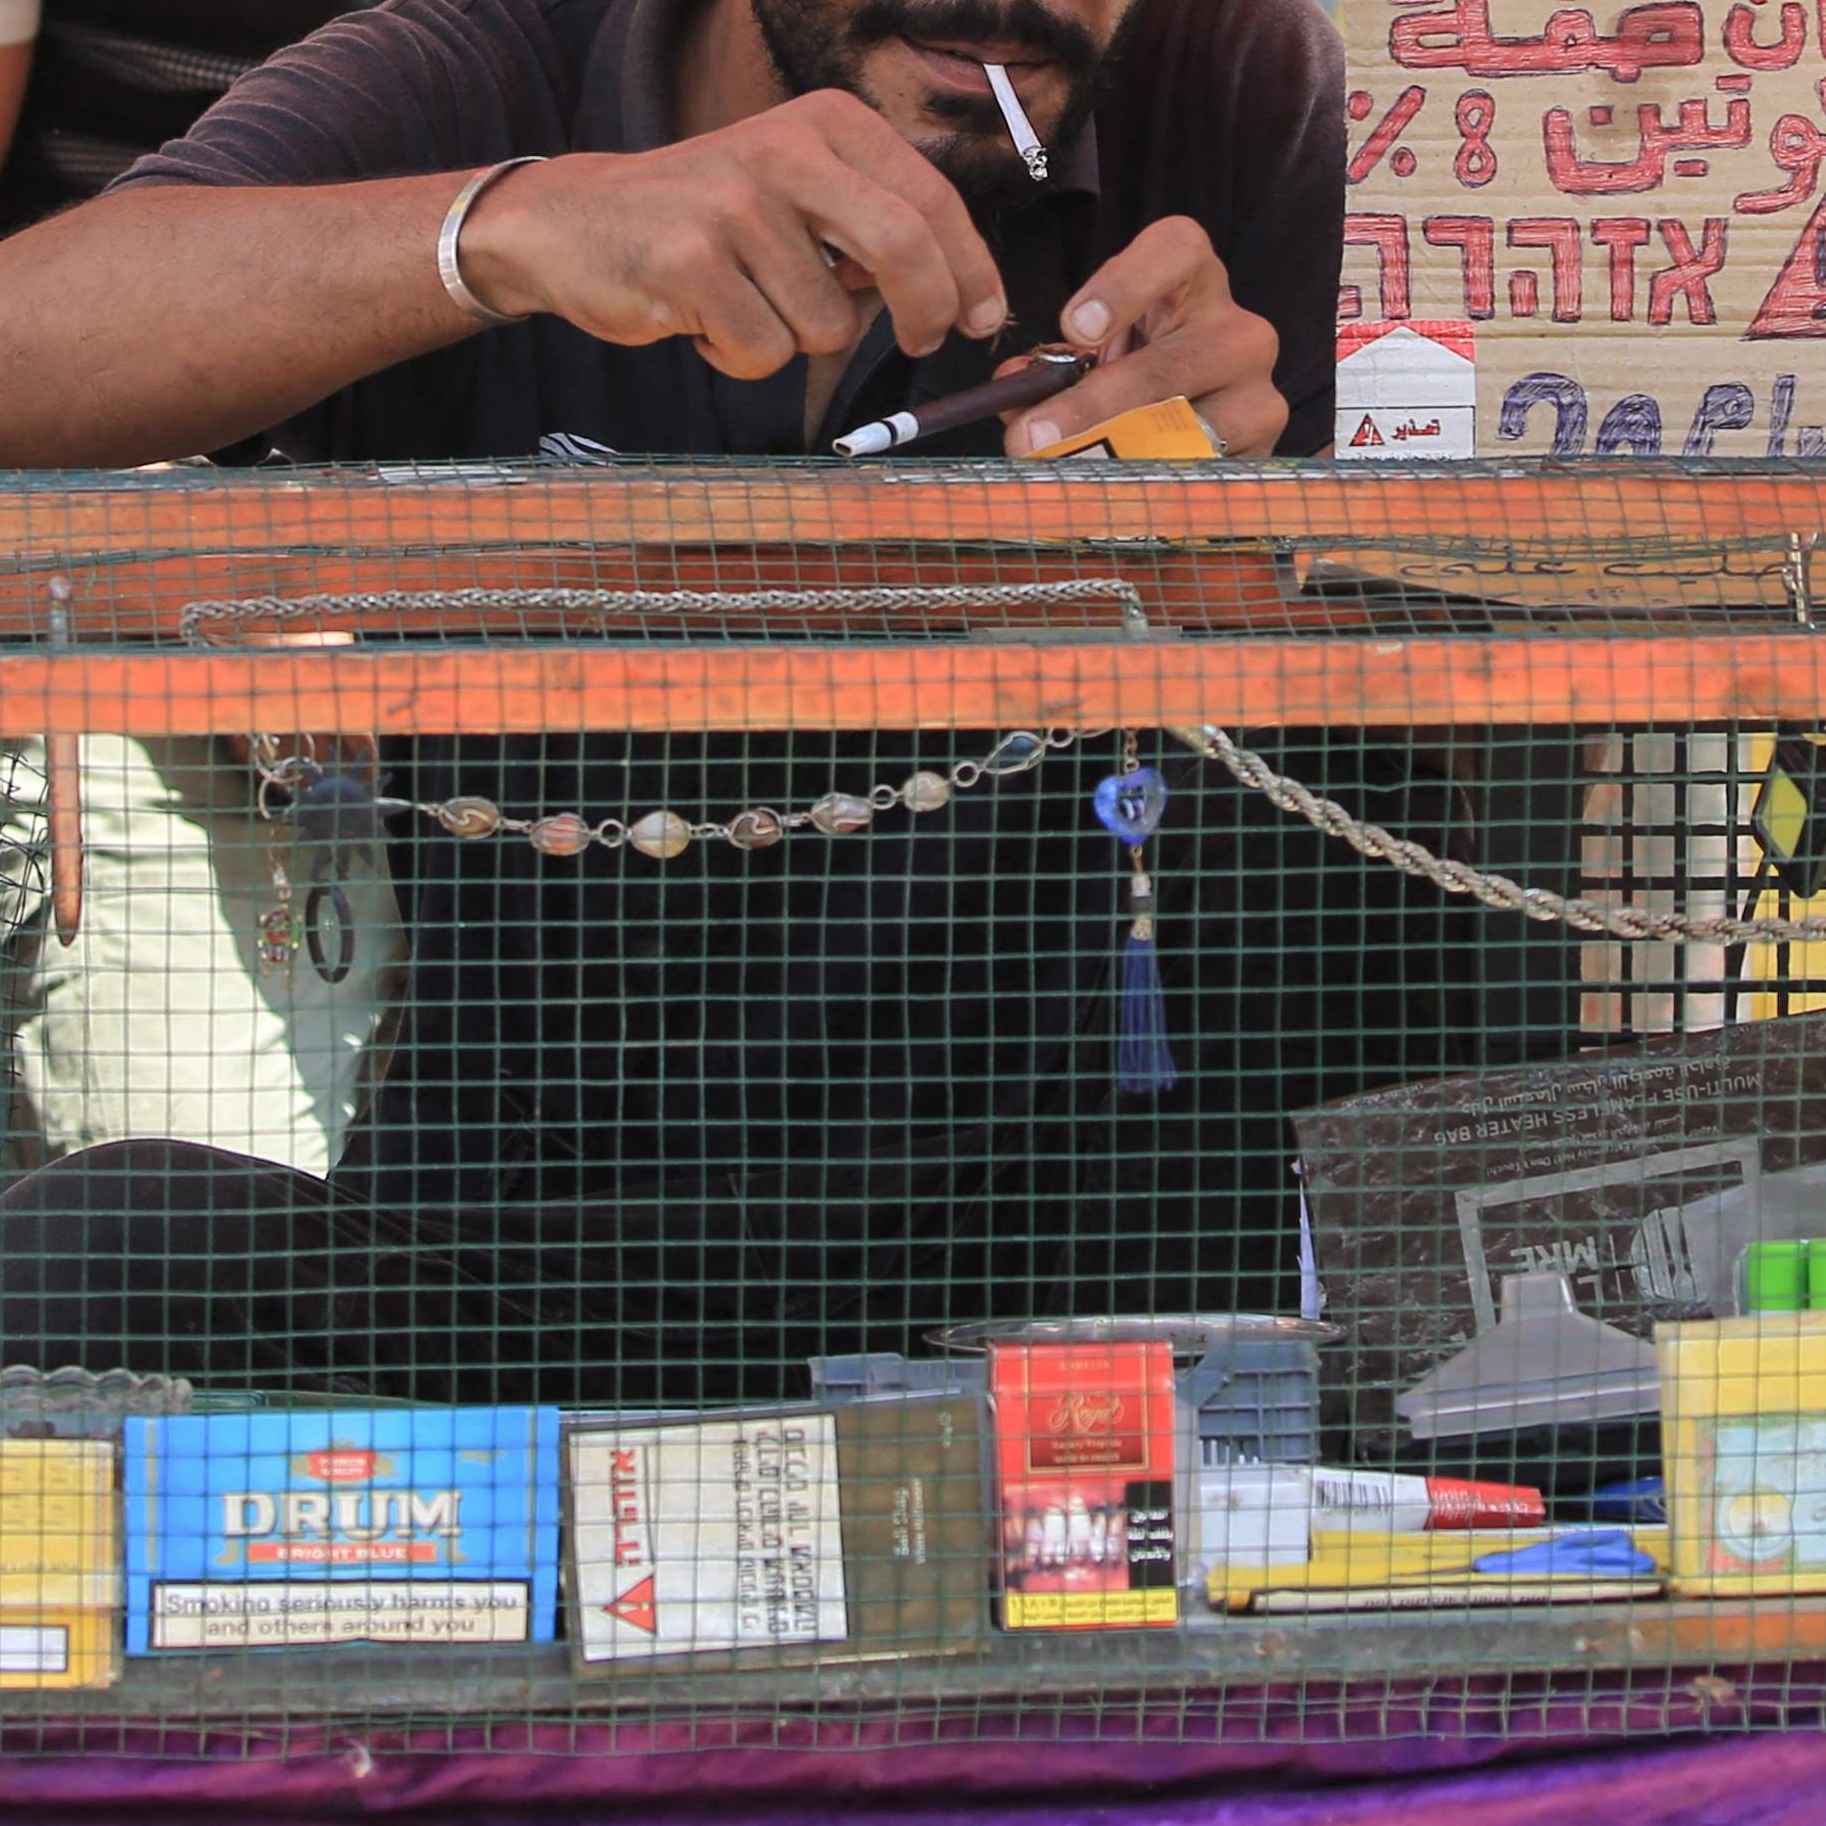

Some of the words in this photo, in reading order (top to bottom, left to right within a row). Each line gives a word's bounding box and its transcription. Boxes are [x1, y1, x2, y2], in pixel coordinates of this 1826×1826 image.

[1391, 418, 1442, 441] تحذير
[1663, 1072, 1761, 1103] MULTI-USE
[1433, 1126, 1471, 1147] BAG
[1474, 1111, 1548, 1138] HEATER
[222, 1489, 463, 1540] DRUM
[609, 1449, 643, 1568] אזהרה
[167, 1595, 269, 1615] Smoking
[475, 1598, 518, 1610] you
[208, 1620, 250, 1636] and
[259, 1618, 332, 1635] others
[431, 1619, 474, 1633] you
